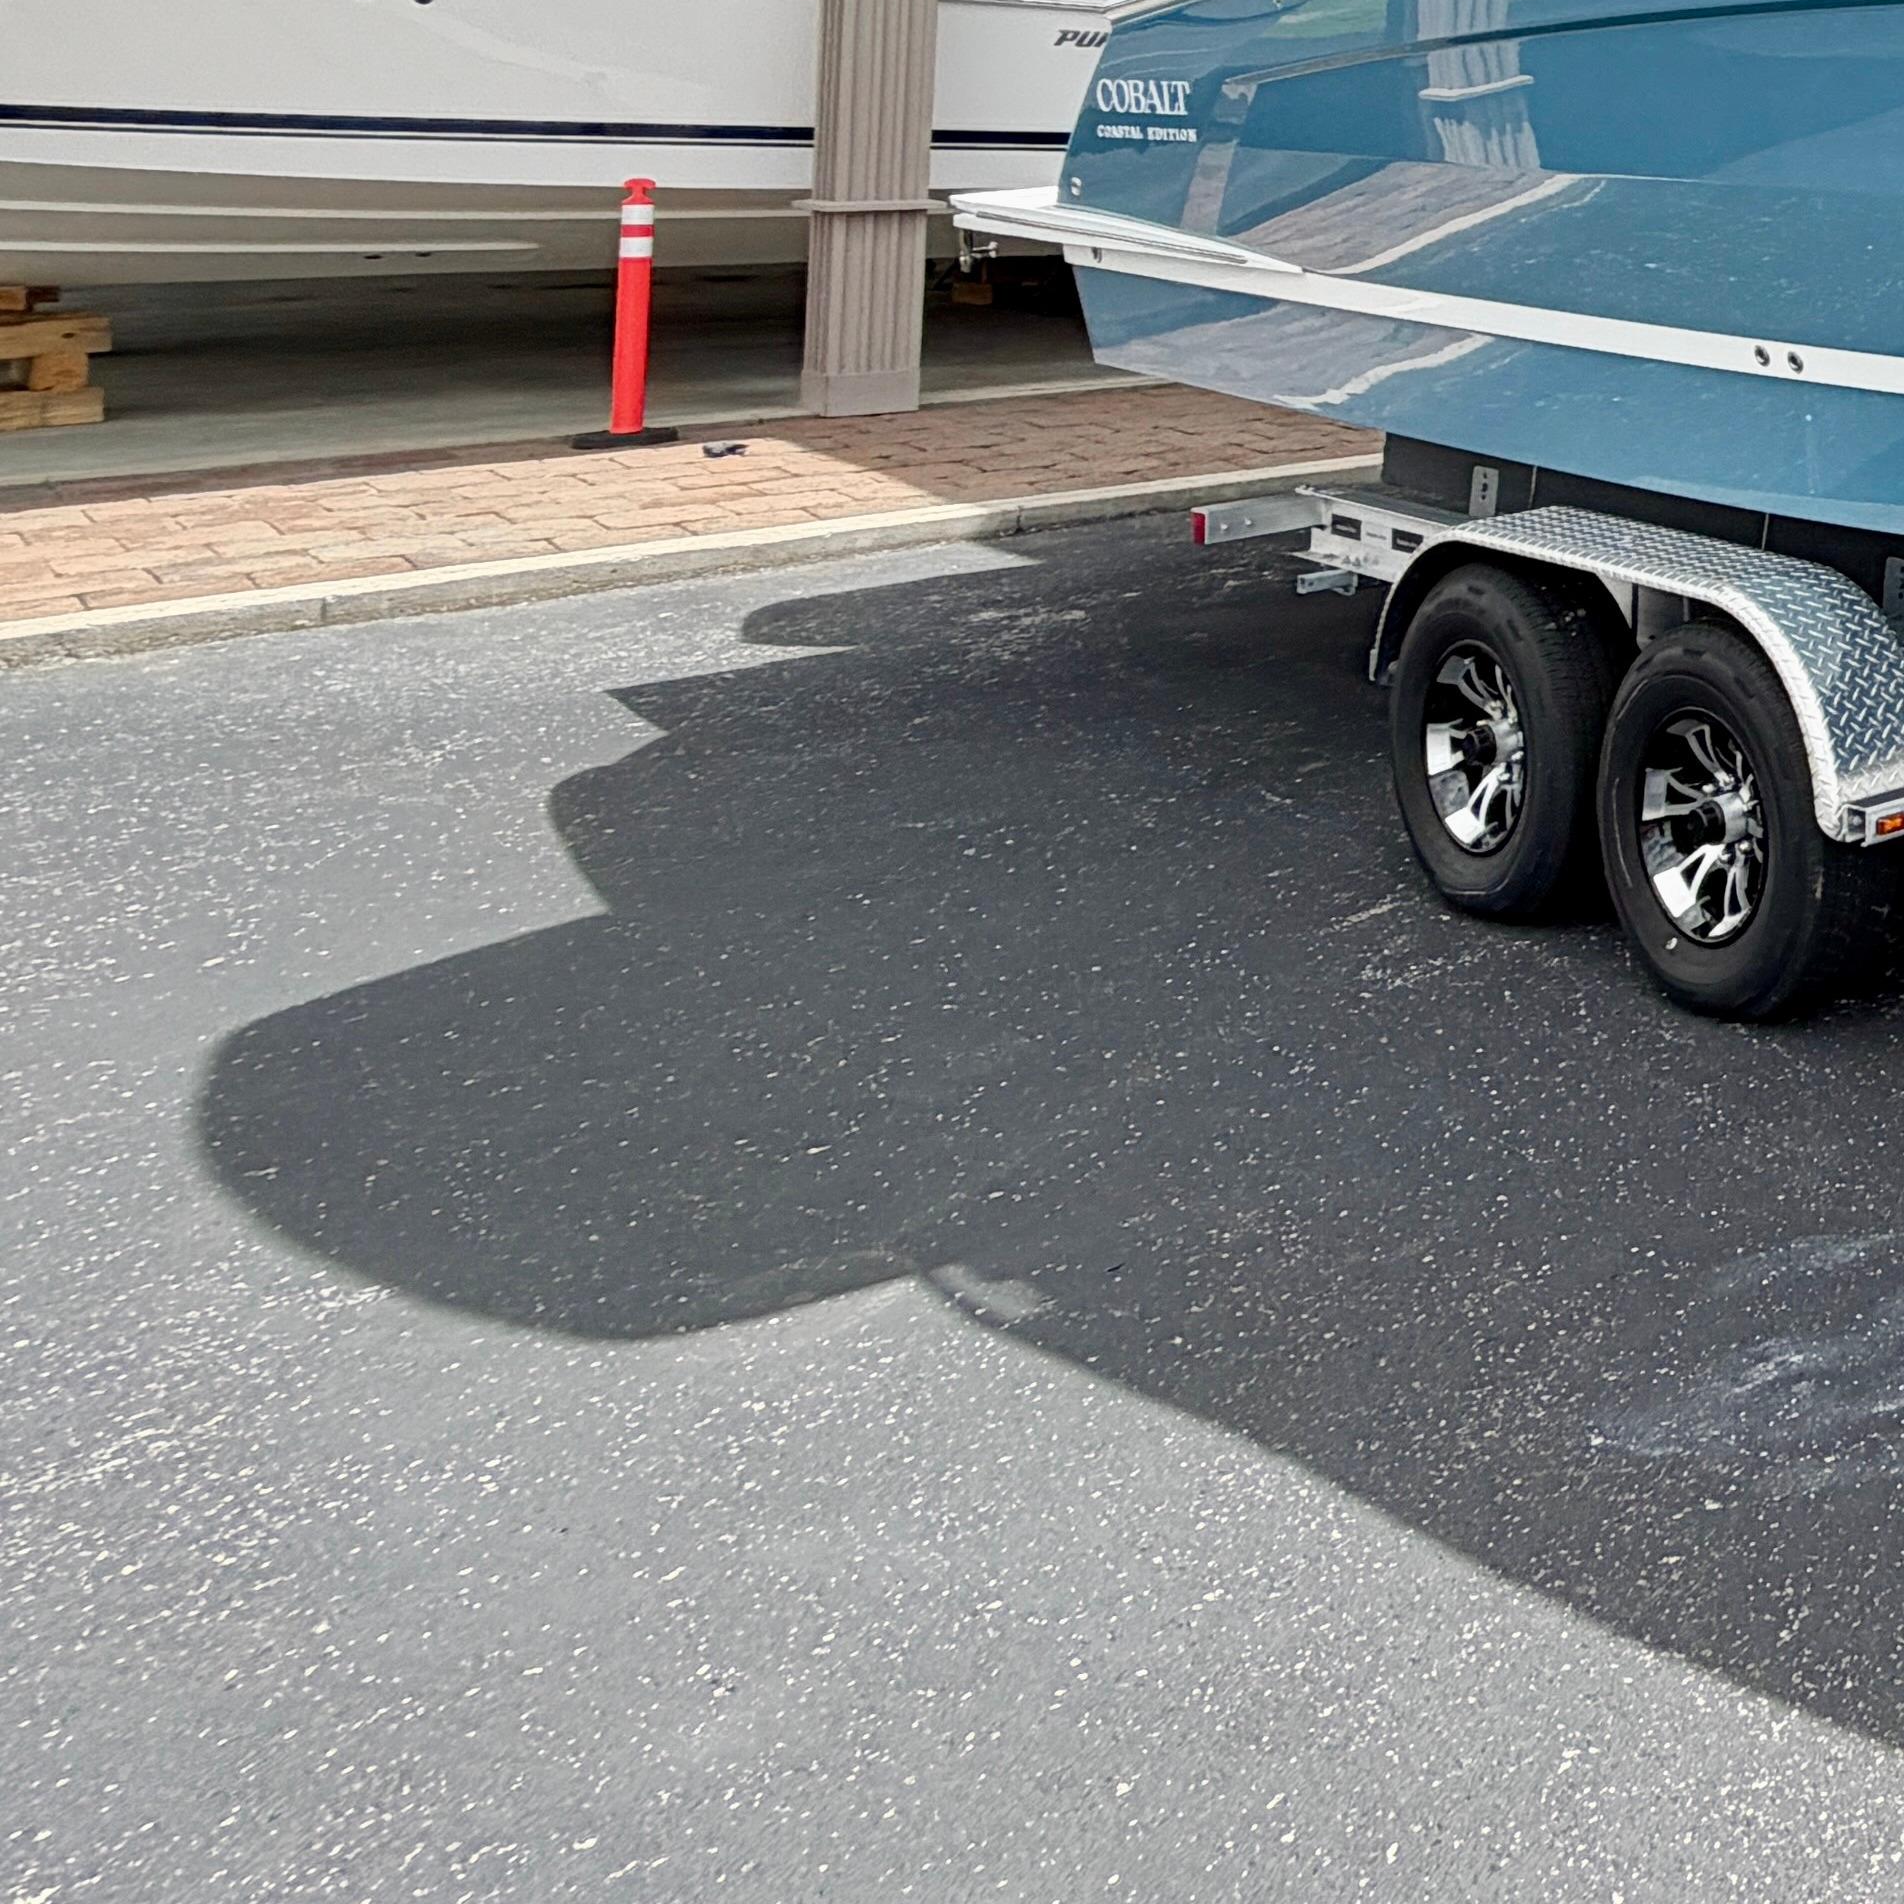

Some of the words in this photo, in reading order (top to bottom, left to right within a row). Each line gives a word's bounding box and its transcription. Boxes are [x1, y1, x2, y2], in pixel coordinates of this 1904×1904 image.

[1097, 78, 1191, 115] COBALT
[1097, 124, 1144, 139] COASTAL
[1146, 126, 1197, 142] EDITION
